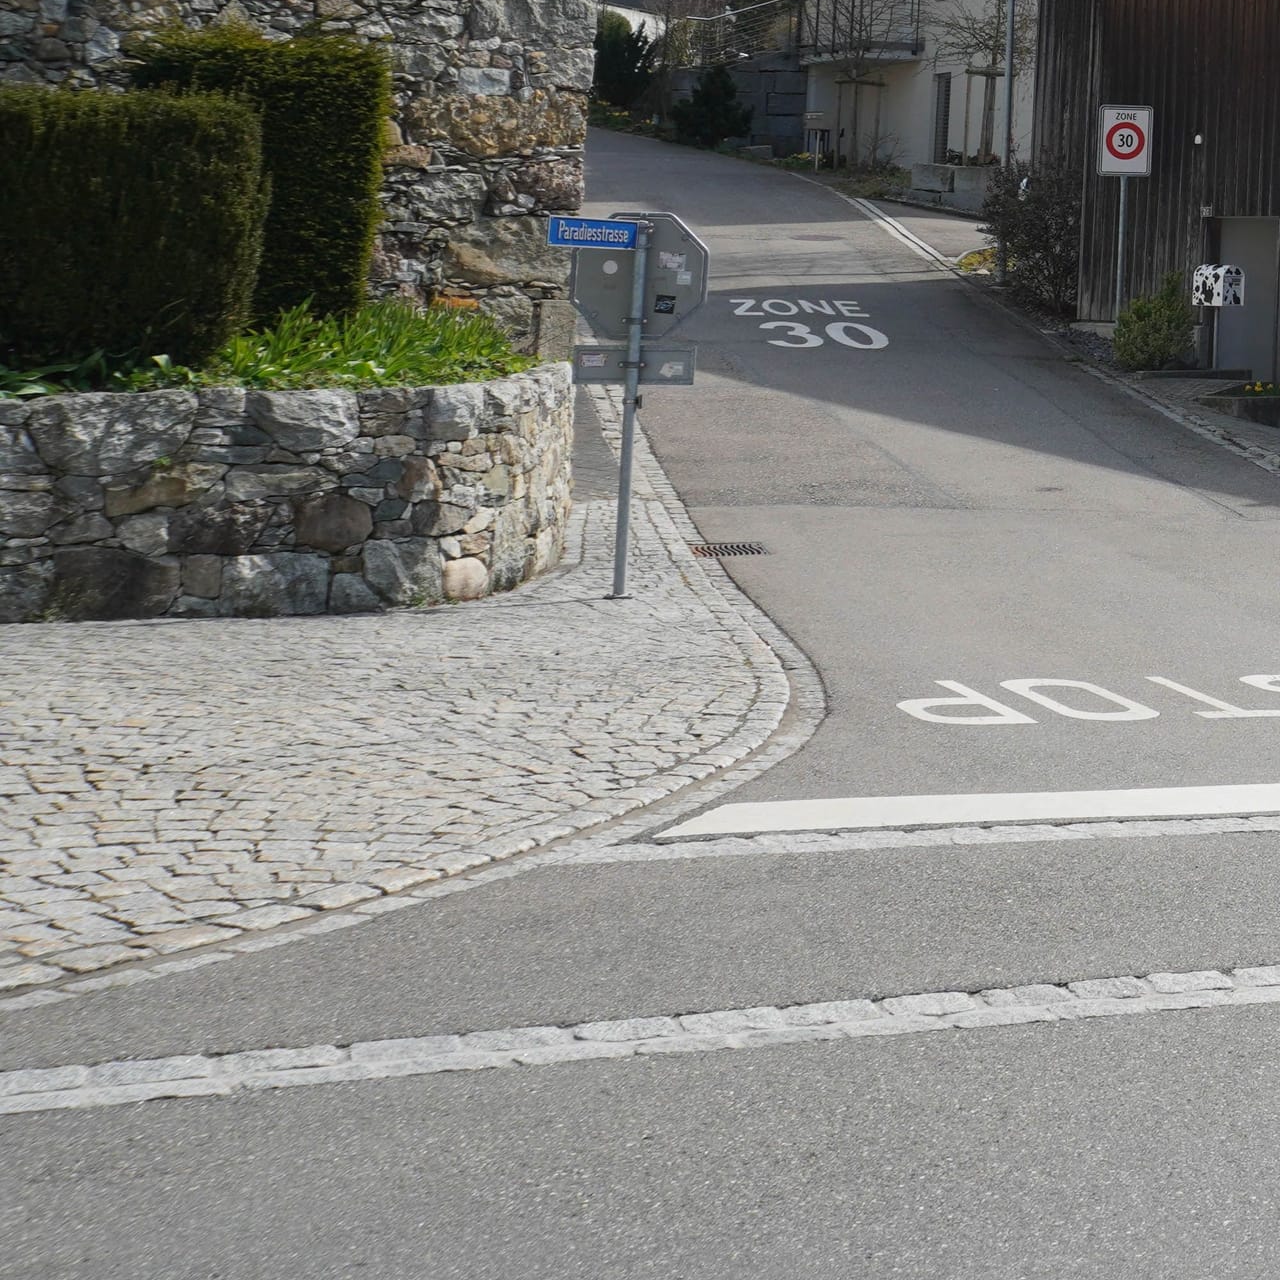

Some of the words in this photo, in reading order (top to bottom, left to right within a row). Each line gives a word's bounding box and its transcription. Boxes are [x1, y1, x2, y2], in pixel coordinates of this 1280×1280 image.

[1115, 112, 1137, 121] ZONE
[1118, 134, 1134, 148] 30
[558, 220, 630, 243] Paradiesstrasse
[729, 299, 871, 318] ZONE
[759, 321, 890, 350] 30
